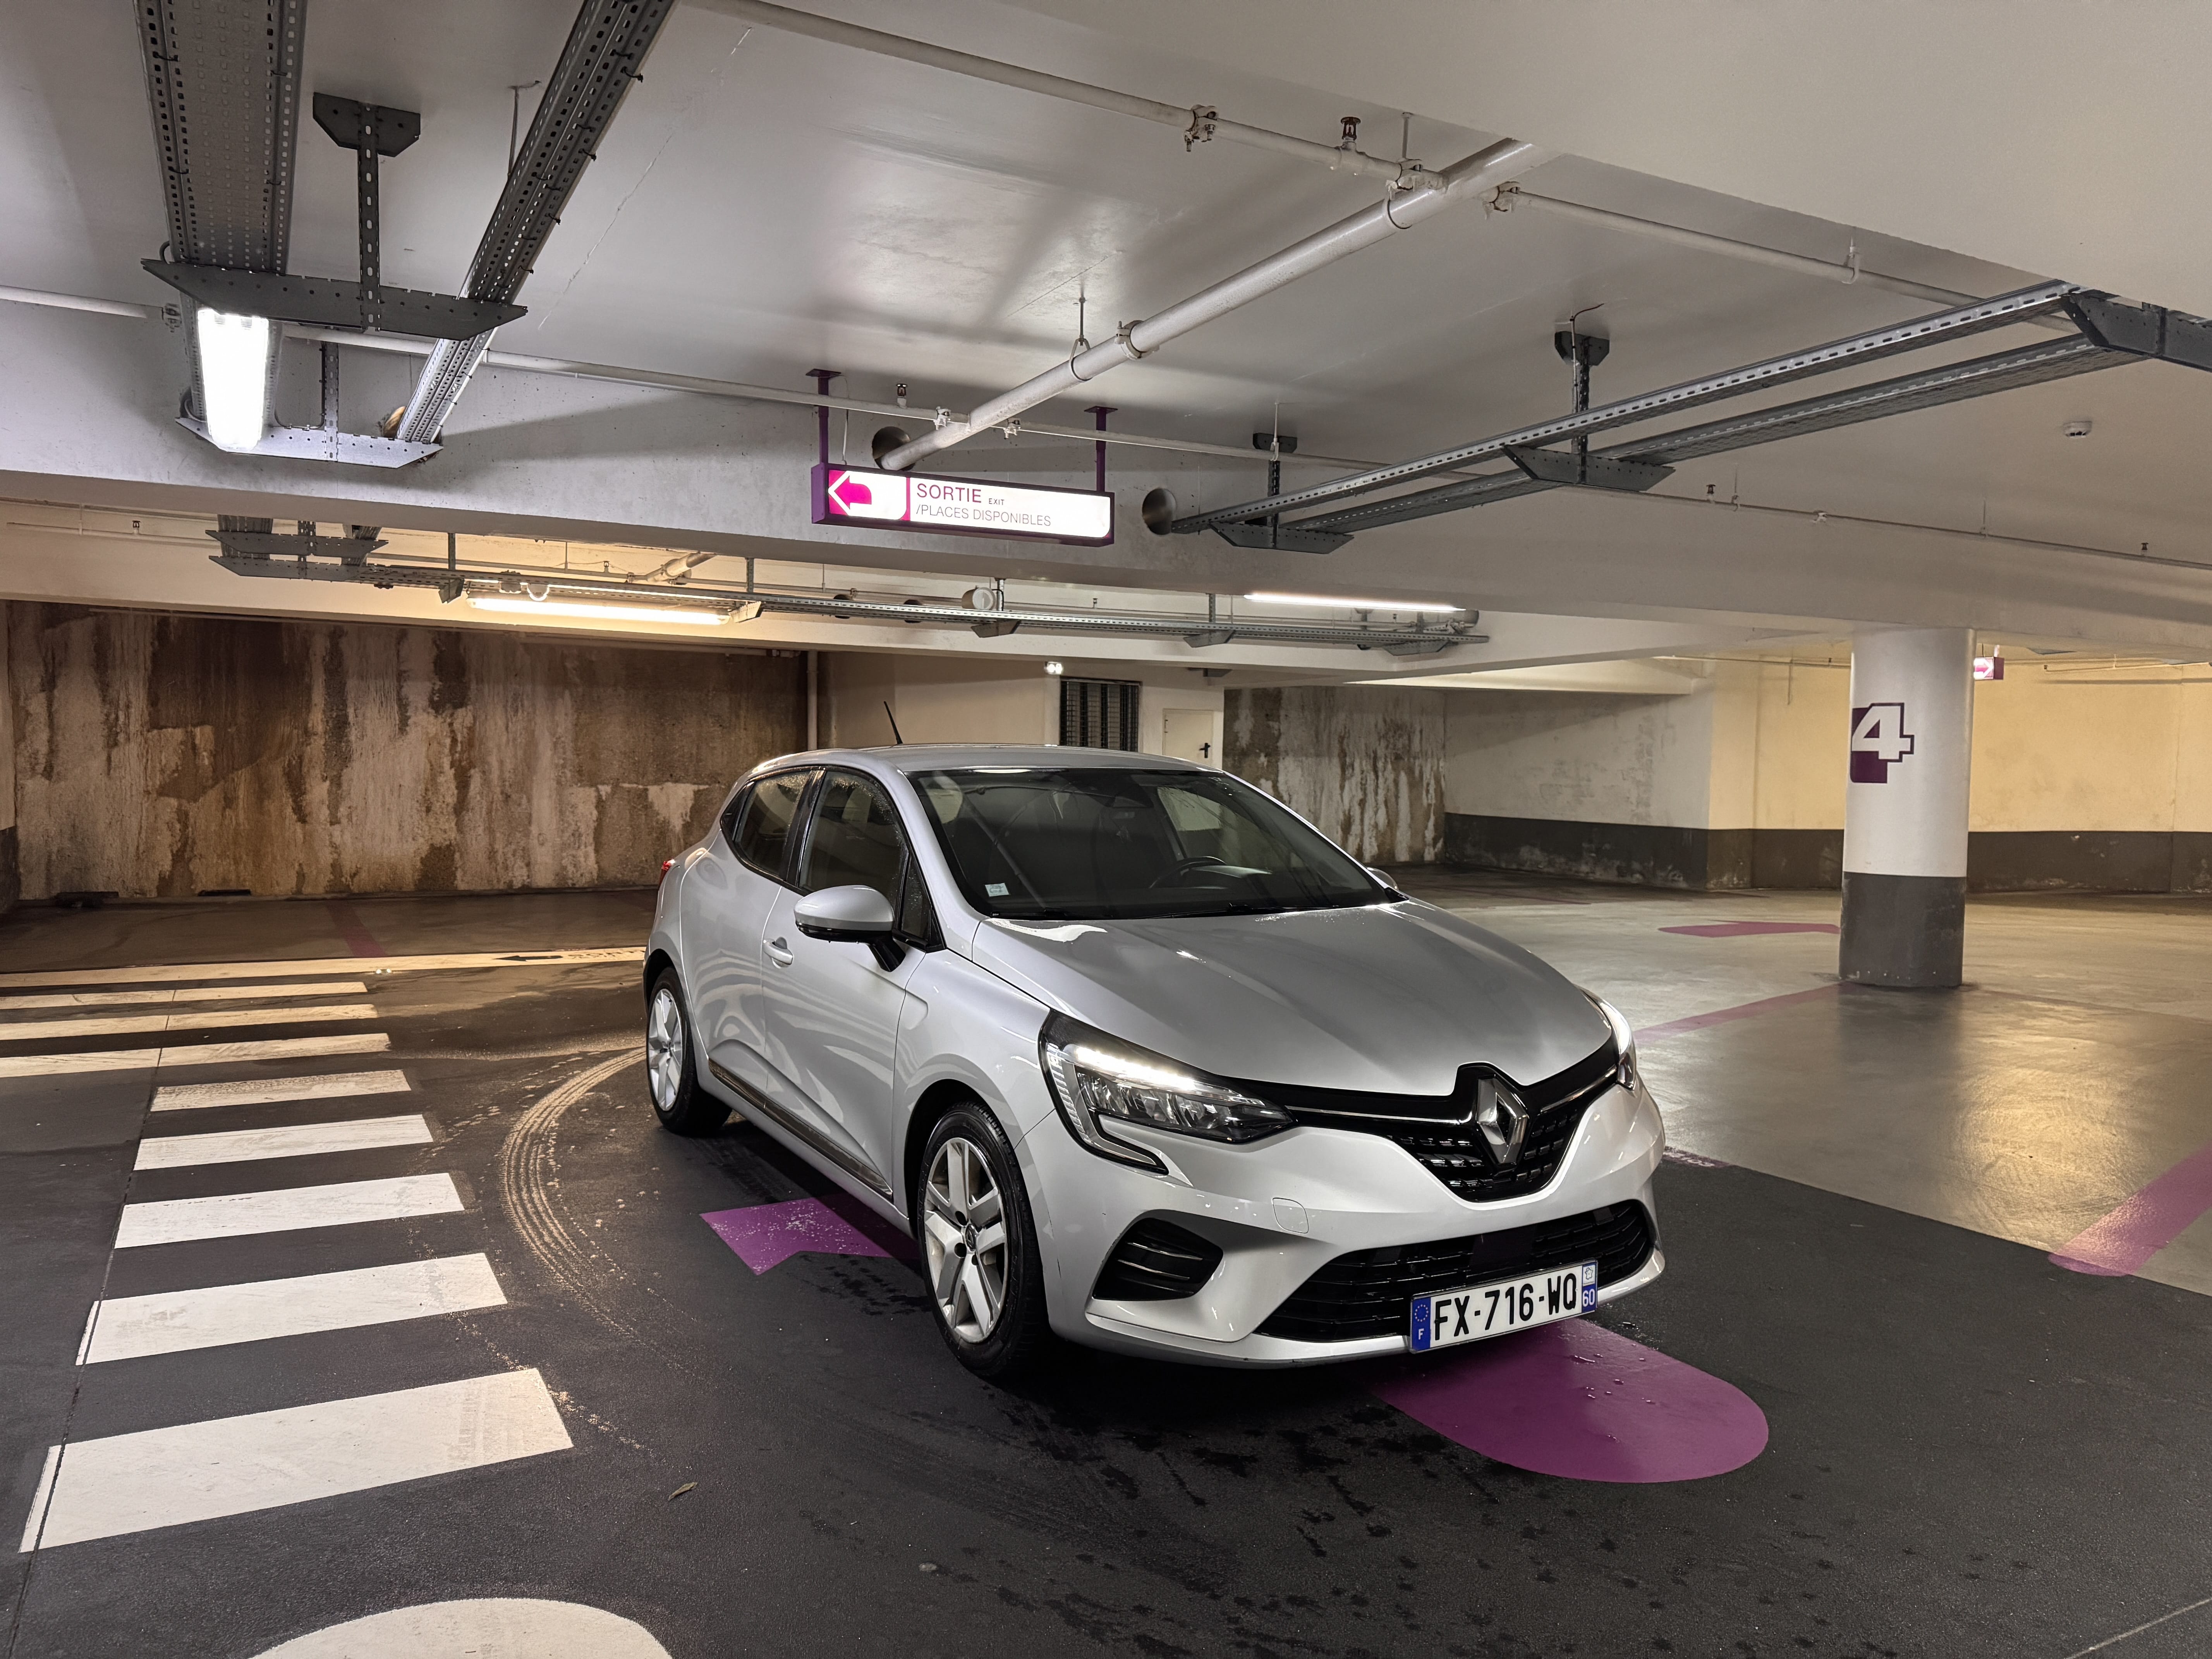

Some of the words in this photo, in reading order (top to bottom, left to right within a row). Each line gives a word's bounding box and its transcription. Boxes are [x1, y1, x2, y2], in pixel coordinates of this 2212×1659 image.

[917, 483, 982, 503] SORTIE
[916, 504, 969, 519] /PLACES
[974, 509, 1051, 526] DISPONIBLES
[1851, 703, 1914, 762] 4
[1434, 1273, 1577, 1341] FX-716-WQ
[1582, 1288, 1595, 1307] 60
[1418, 1328, 1424, 1340] F
